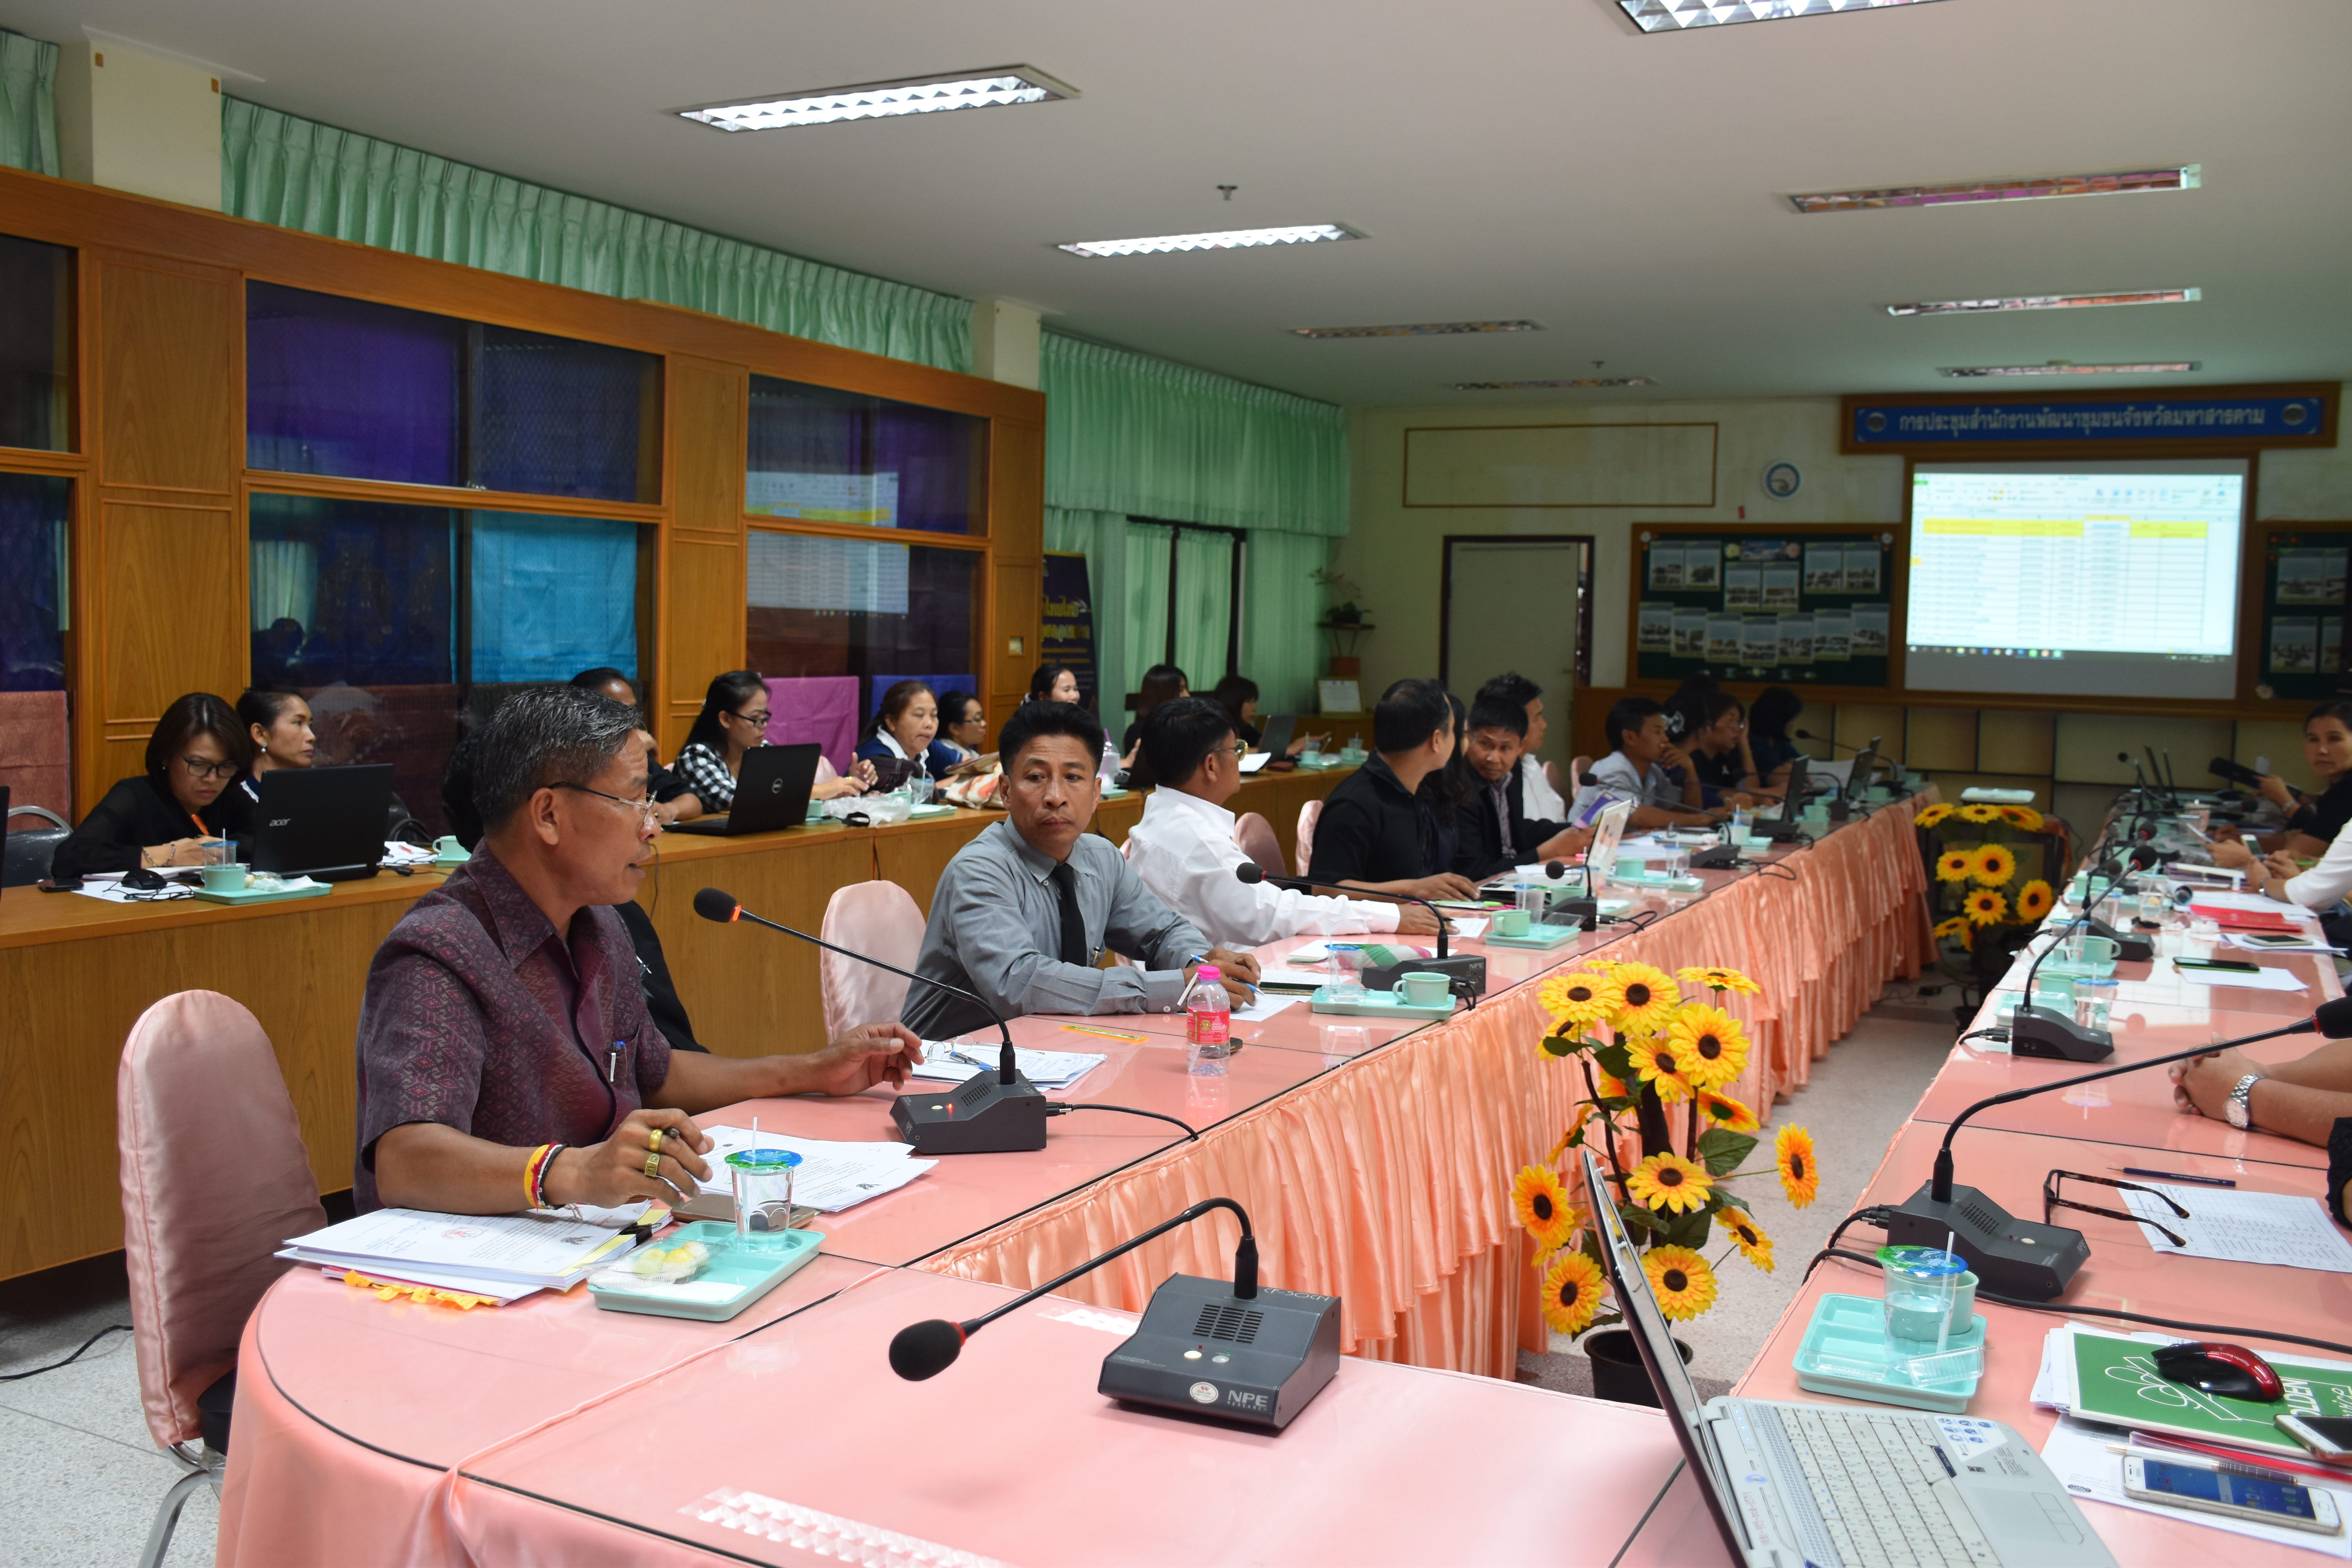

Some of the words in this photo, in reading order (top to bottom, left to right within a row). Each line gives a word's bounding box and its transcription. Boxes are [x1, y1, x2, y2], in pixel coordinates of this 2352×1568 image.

[269, 818, 291, 827] acer
[2234, 1355, 2250, 1367] capability
[1228, 1390, 1268, 1407] NPE
[1227, 1400, 1267, 1411] RESEARCH
